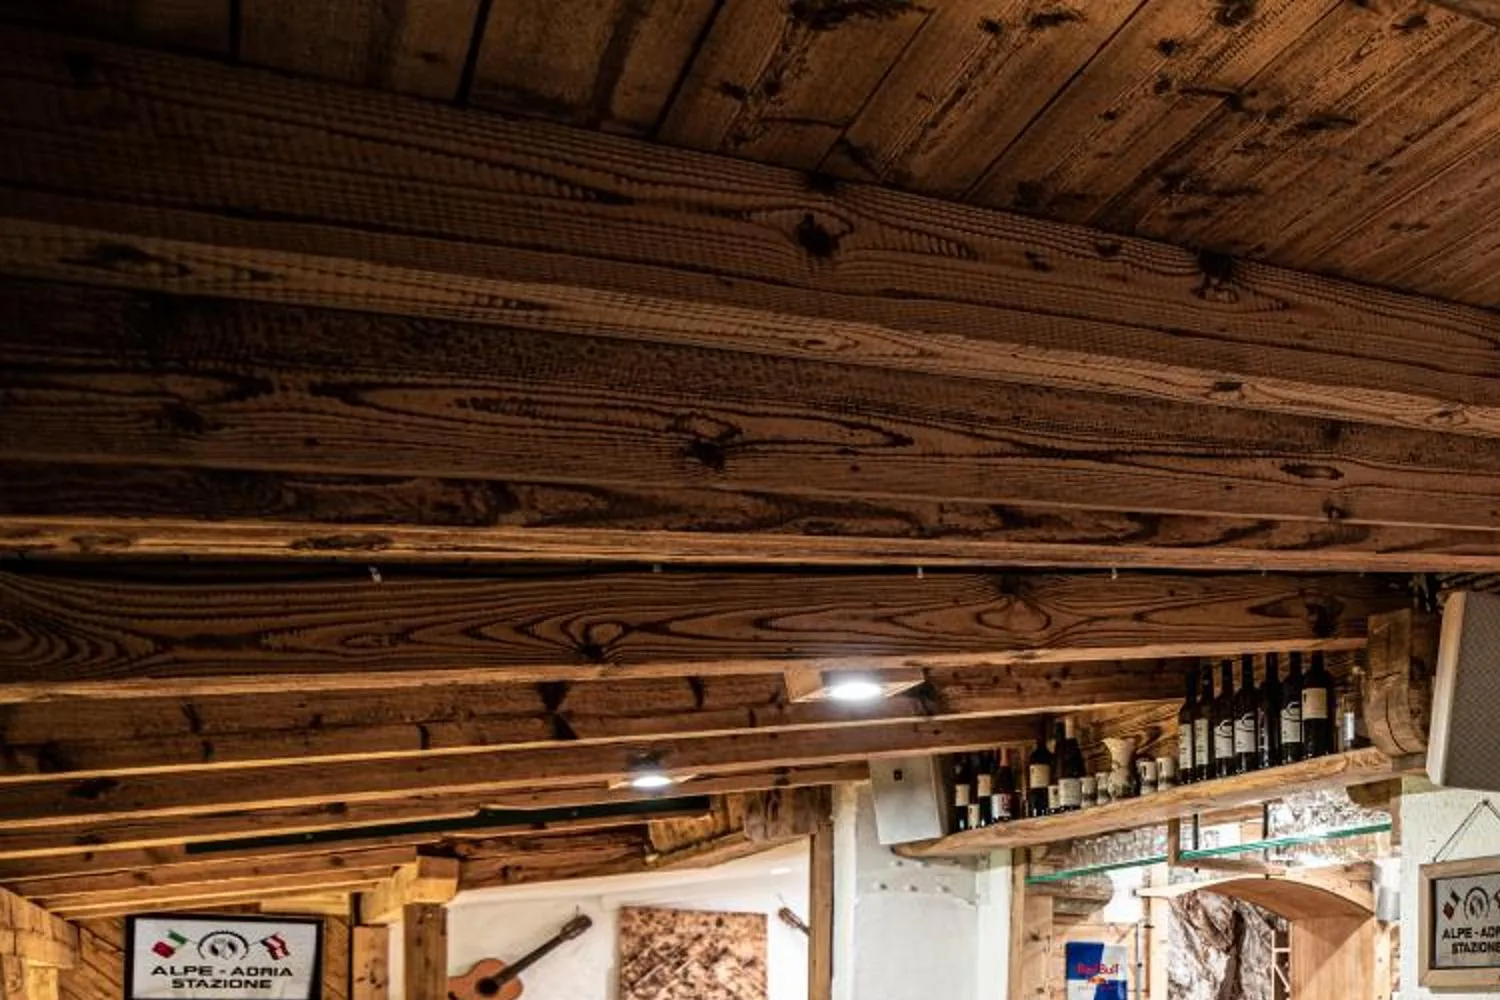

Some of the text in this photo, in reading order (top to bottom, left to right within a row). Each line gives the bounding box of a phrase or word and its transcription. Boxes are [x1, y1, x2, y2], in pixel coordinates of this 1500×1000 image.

[1442, 927, 1473, 940] ALPE
[151, 965, 213, 977] ALPE
[230, 966, 293, 977] ADRIA
[171, 979, 272, 989] STAZIONE
